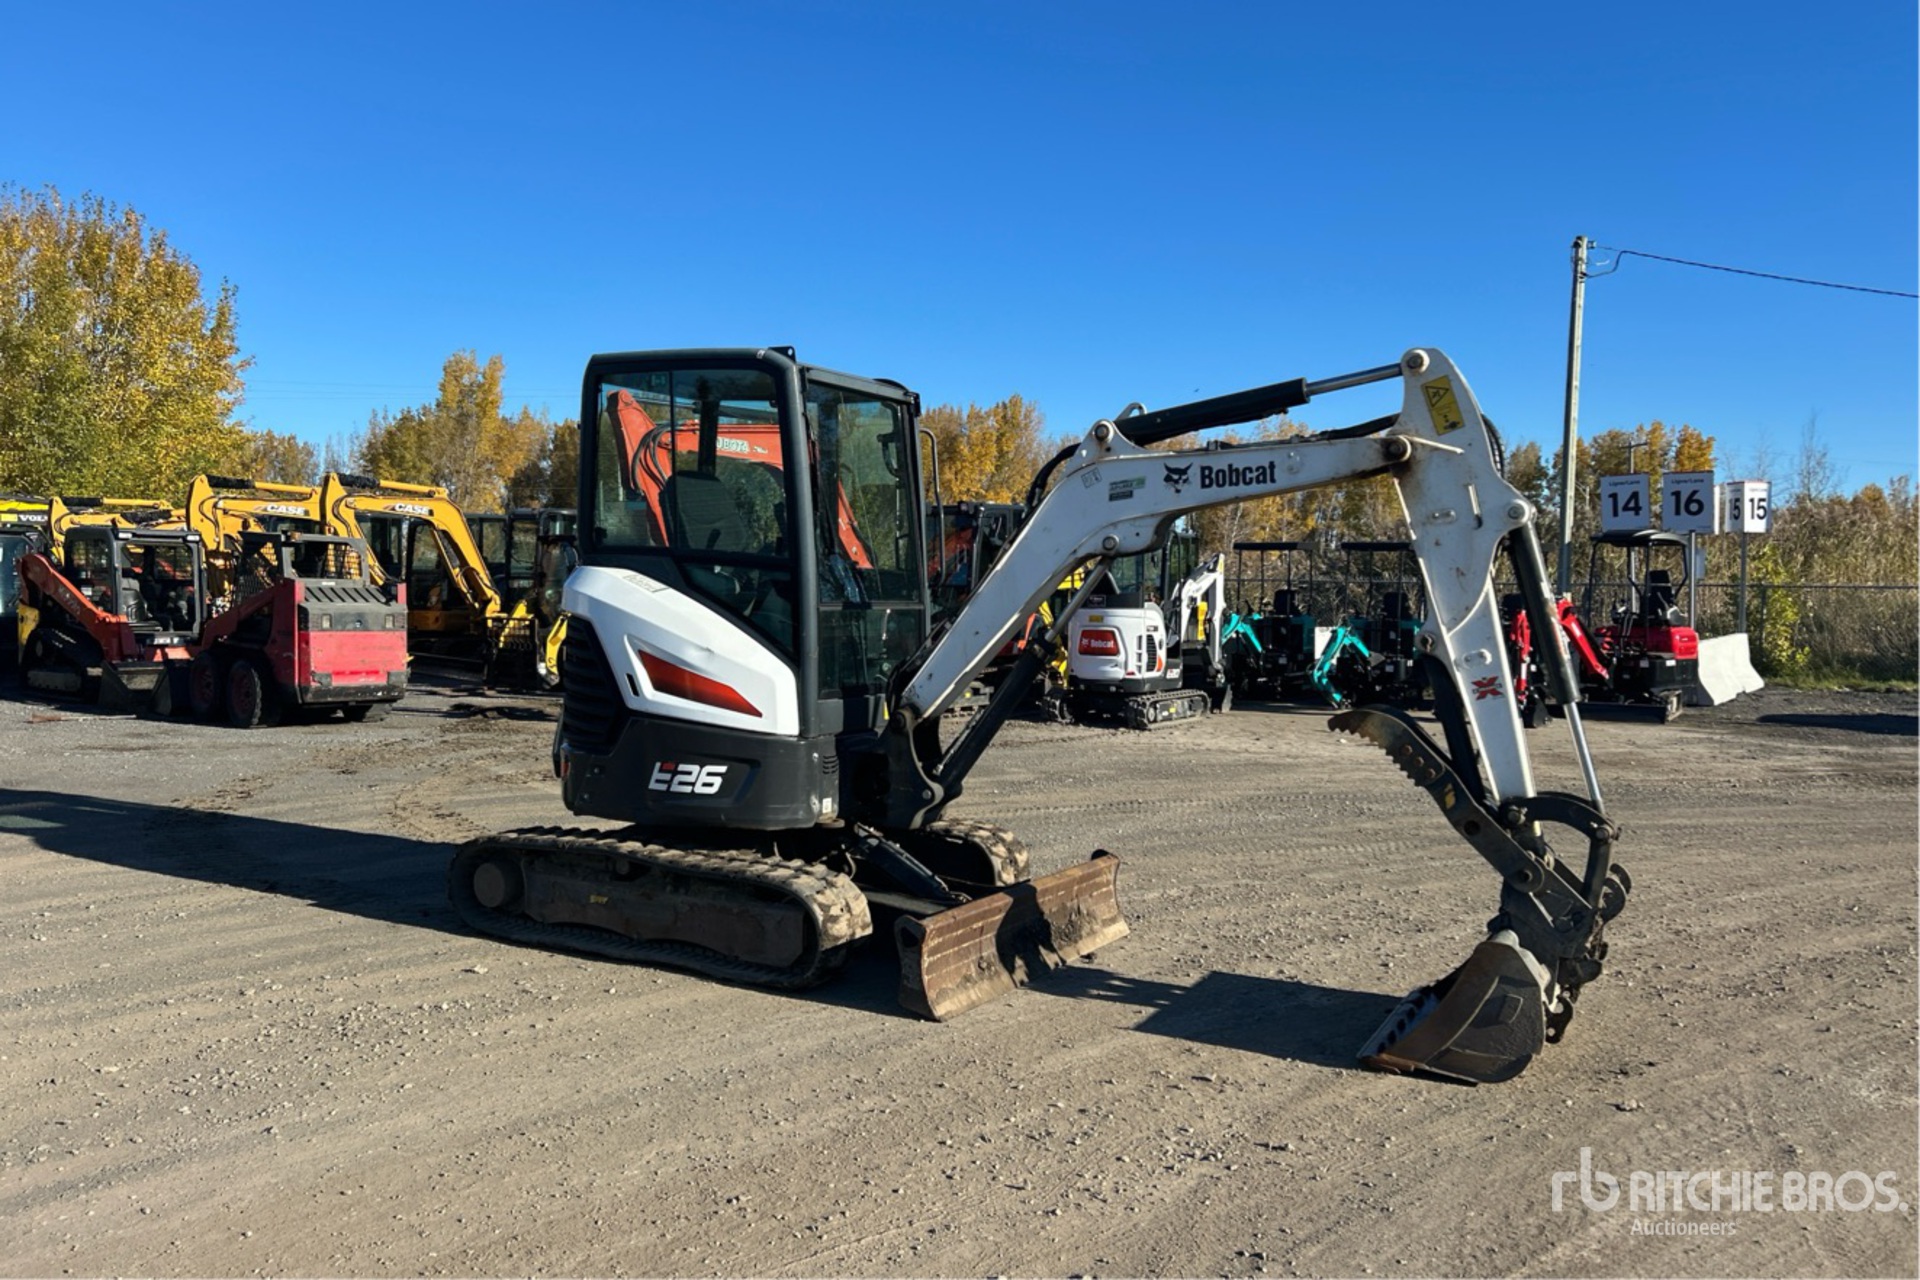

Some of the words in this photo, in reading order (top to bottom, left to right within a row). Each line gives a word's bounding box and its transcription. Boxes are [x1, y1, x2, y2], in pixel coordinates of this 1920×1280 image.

[1200, 460, 1277, 489] Bobcat
[266, 504, 306, 515] CASE
[394, 503, 429, 515] CASE
[1607, 490, 1643, 518] 14
[1670, 489, 1705, 517] 16
[1748, 497, 1767, 520] 15
[1090, 639, 1114, 648] Bobcat
[648, 761, 728, 795] E26
